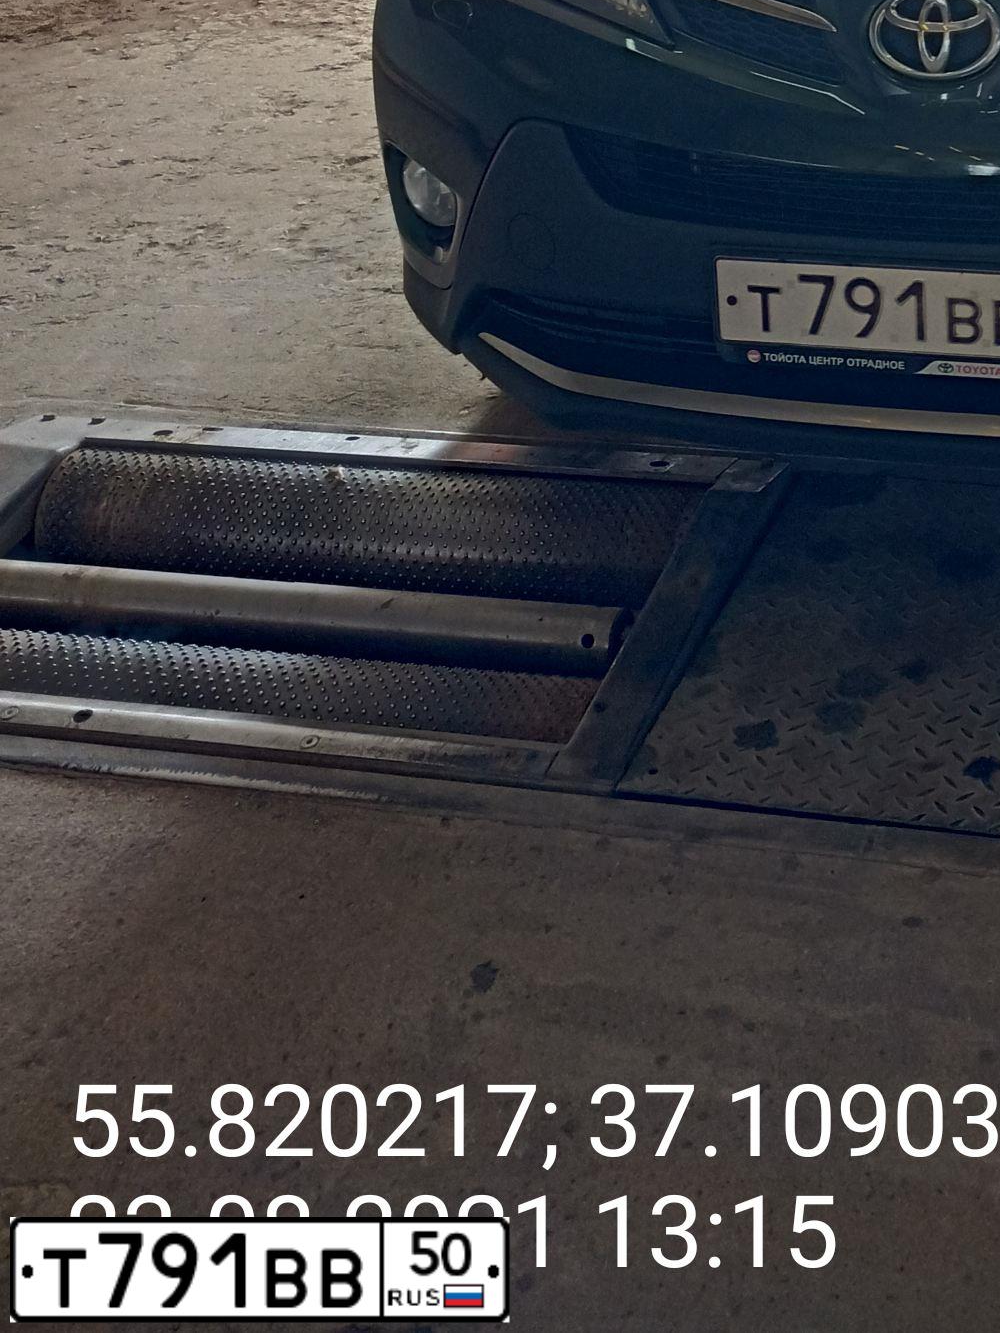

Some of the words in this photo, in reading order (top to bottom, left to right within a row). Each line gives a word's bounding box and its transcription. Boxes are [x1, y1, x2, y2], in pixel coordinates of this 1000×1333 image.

[763, 352, 806, 364] ТОЙОТА
[809, 355, 844, 366] ЦЕНТР
[846, 358, 905, 370] ОТРАДНОЕ
